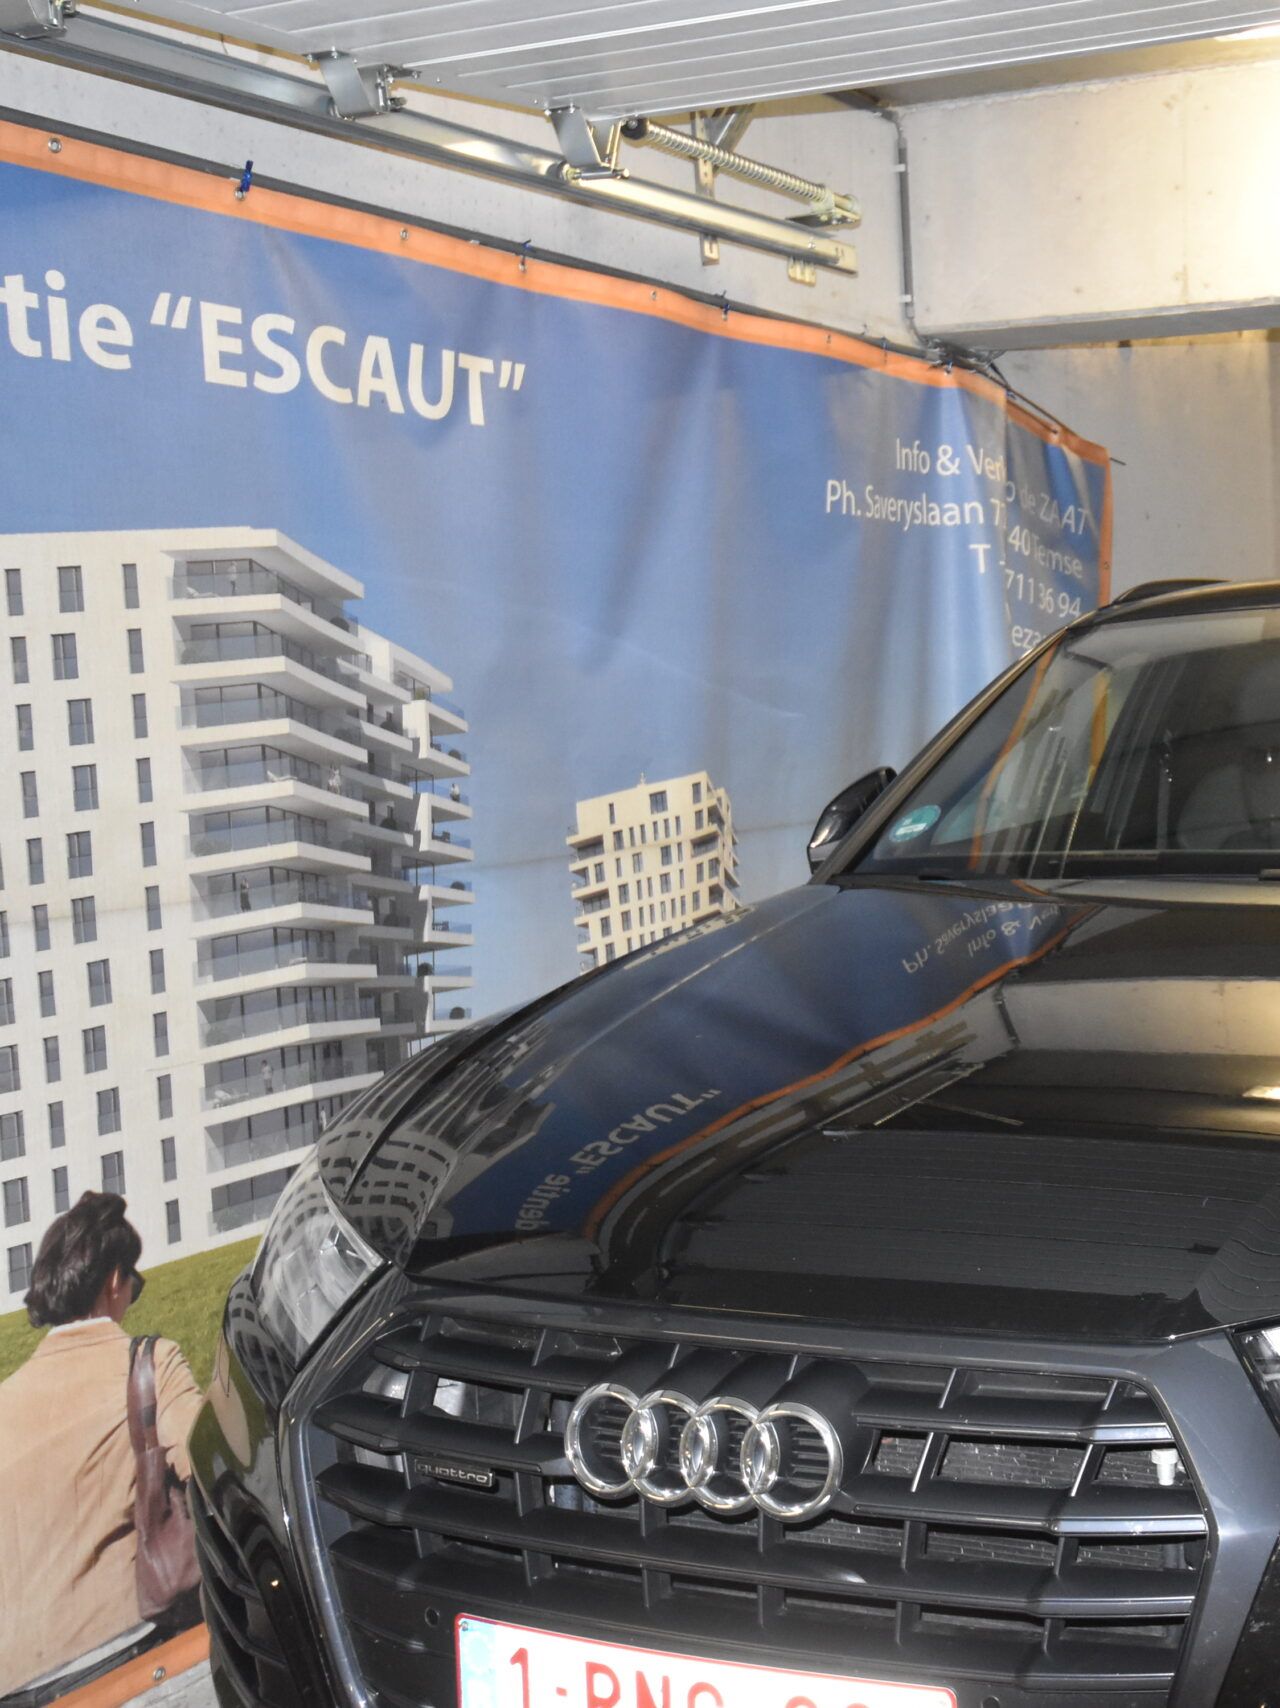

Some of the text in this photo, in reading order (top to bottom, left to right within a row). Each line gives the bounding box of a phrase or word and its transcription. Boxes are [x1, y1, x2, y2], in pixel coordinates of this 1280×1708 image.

[896, 437, 930, 474] Info
[936, 444, 961, 475] &
[826, 479, 862, 517] Ph.
[864, 484, 985, 532] Saveryslaan
[968, 543, 992, 575] T
[416, 1462, 489, 1484] quattro
